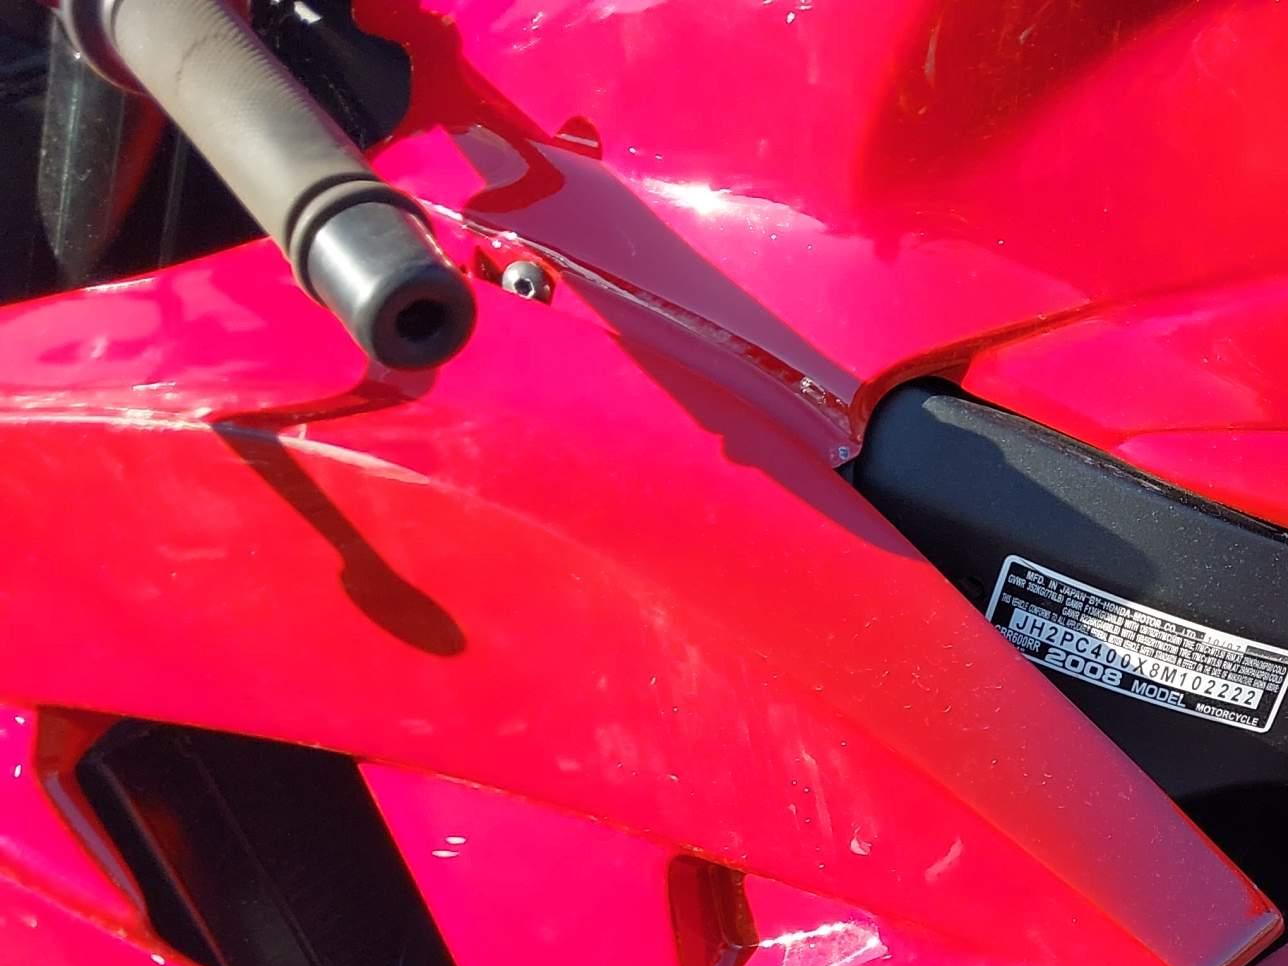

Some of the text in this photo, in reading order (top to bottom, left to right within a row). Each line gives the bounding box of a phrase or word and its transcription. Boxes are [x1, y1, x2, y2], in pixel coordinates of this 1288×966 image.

[1025, 570, 1046, 585] MFD.
[1047, 579, 1058, 590] IN
[1058, 584, 1086, 602] JAPAN
[1087, 595, 1101, 607] BY
[1101, 600, 1132, 618] HONDA
[1132, 611, 1161, 628] MOTOR
[1013, 612, 1257, 706] JH2PC400X8M102222
[1043, 646, 1124, 687] 2008
[1130, 678, 1189, 707] MODEL
[1194, 702, 1259, 726] MOTORCYCLE
[1268, 671, 1284, 682] COLD
[1271, 662, 1288, 674] COLD
